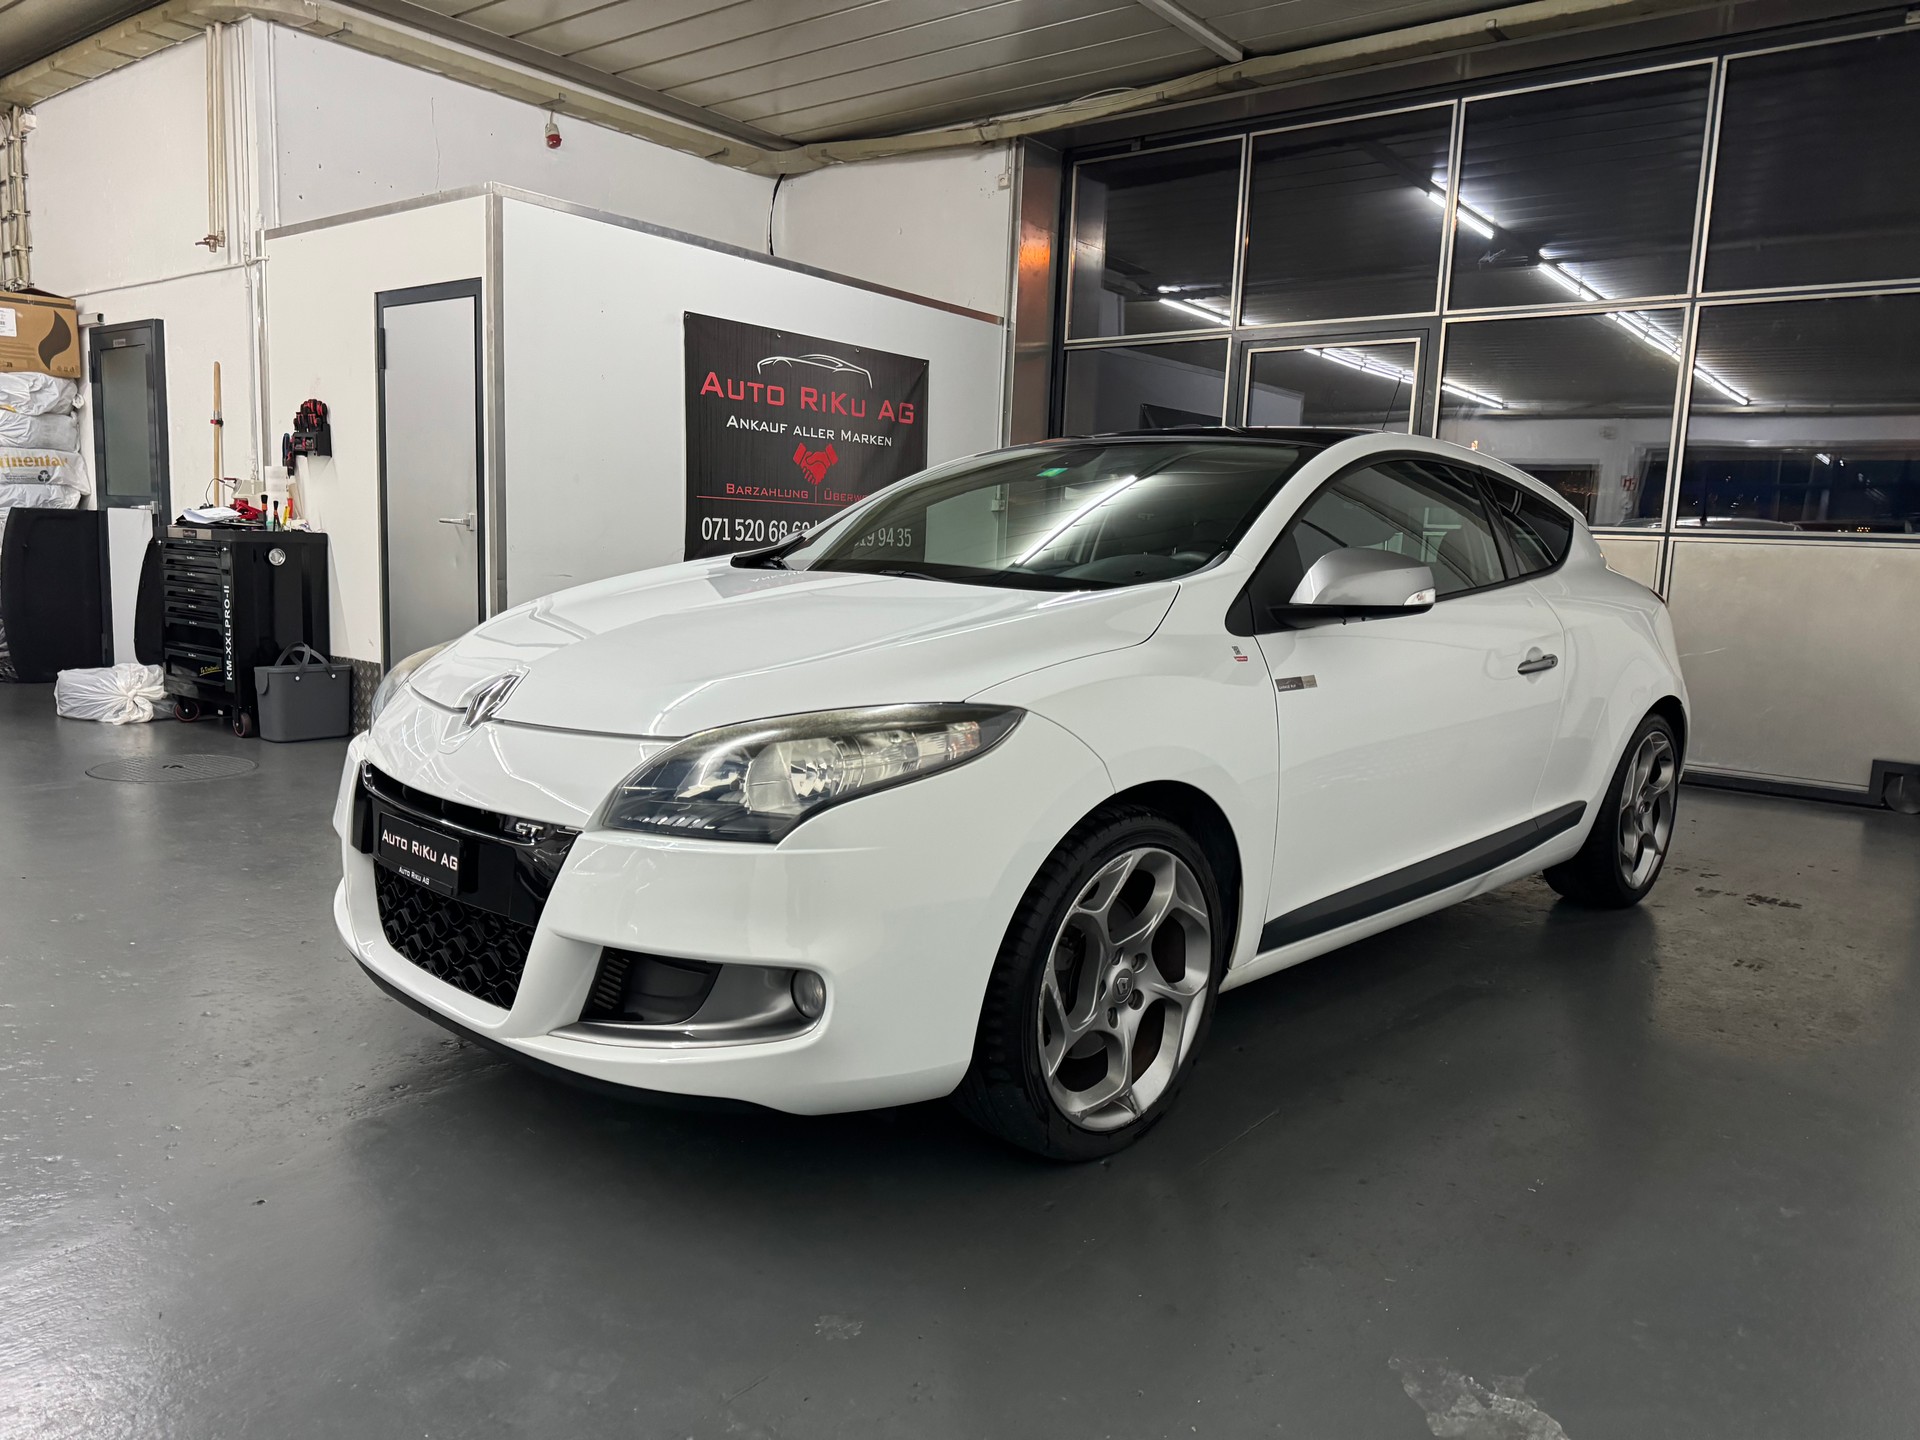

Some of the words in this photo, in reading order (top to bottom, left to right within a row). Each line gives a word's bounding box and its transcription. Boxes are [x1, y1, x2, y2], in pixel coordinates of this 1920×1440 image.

[878, 399, 915, 425] AG
[701, 516, 731, 541] 071
[734, 518, 765, 542] 520
[768, 519, 788, 543] 68
[878, 527, 895, 547] 94
[896, 527, 912, 547] 35
[440, 852, 458, 871] AG
[421, 876, 430, 886] AG
